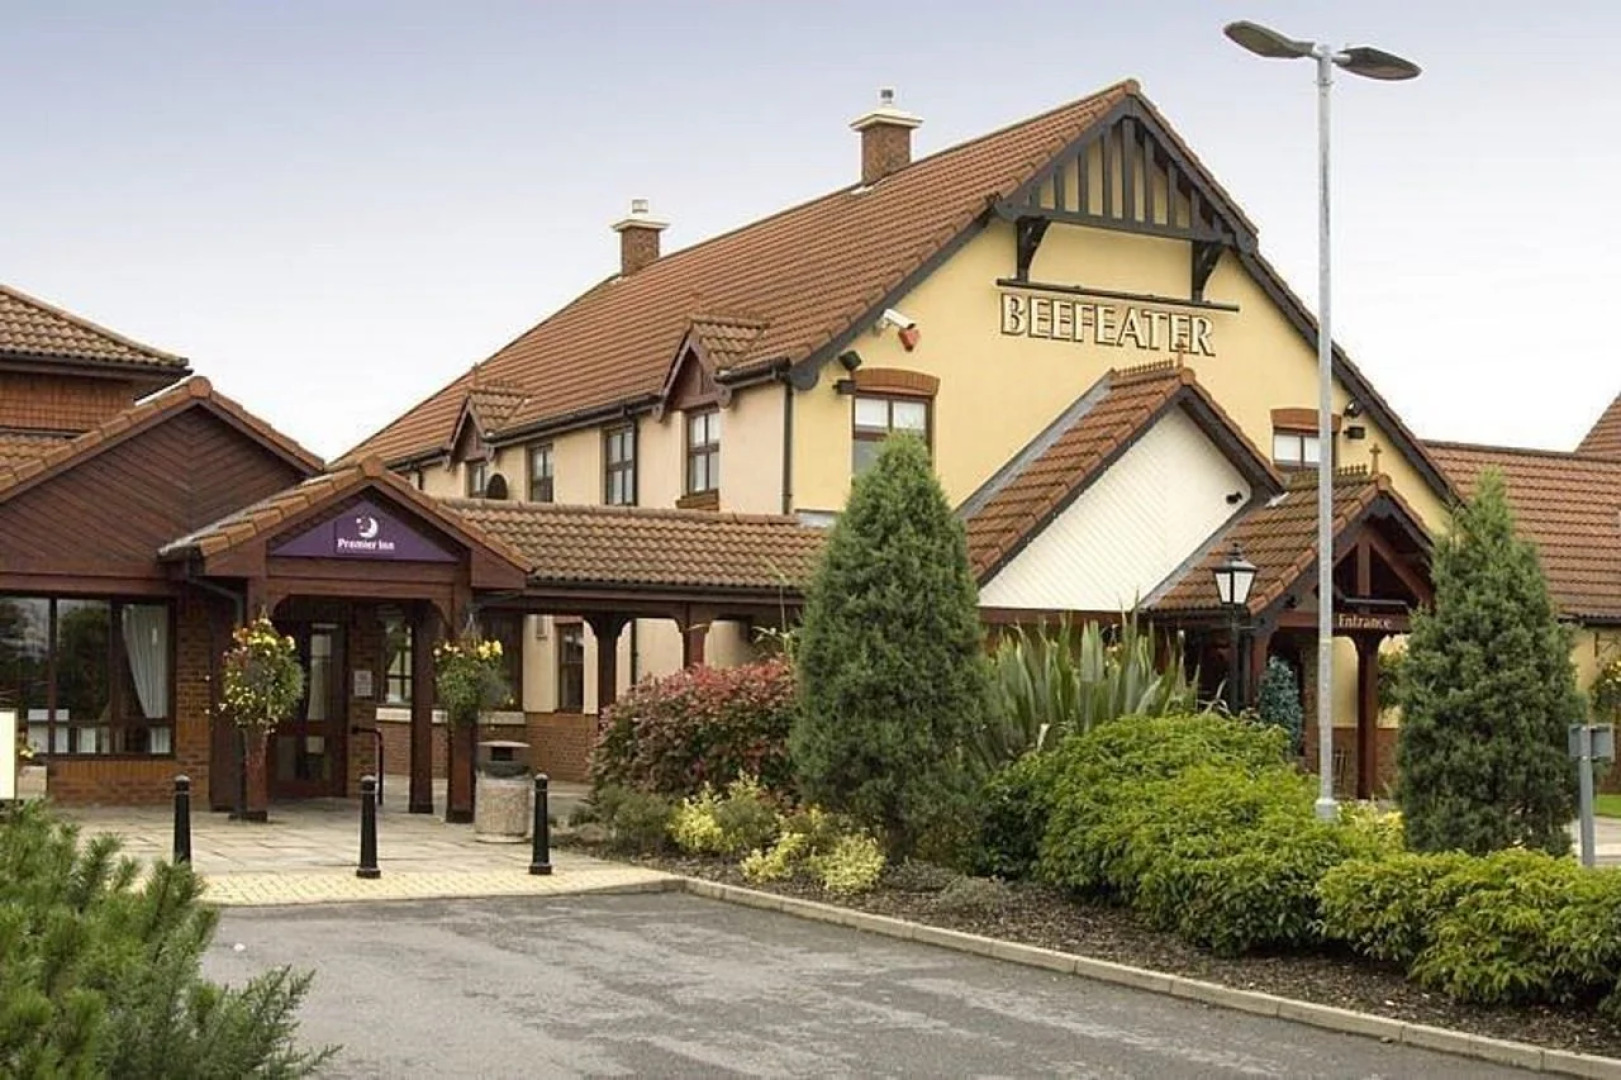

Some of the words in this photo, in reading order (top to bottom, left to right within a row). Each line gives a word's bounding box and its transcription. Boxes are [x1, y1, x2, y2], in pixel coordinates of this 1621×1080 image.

[1001, 293, 1216, 357] BEEFEATER
[337, 538, 377, 550] Premier
[1338, 613, 1393, 629] Entrance
